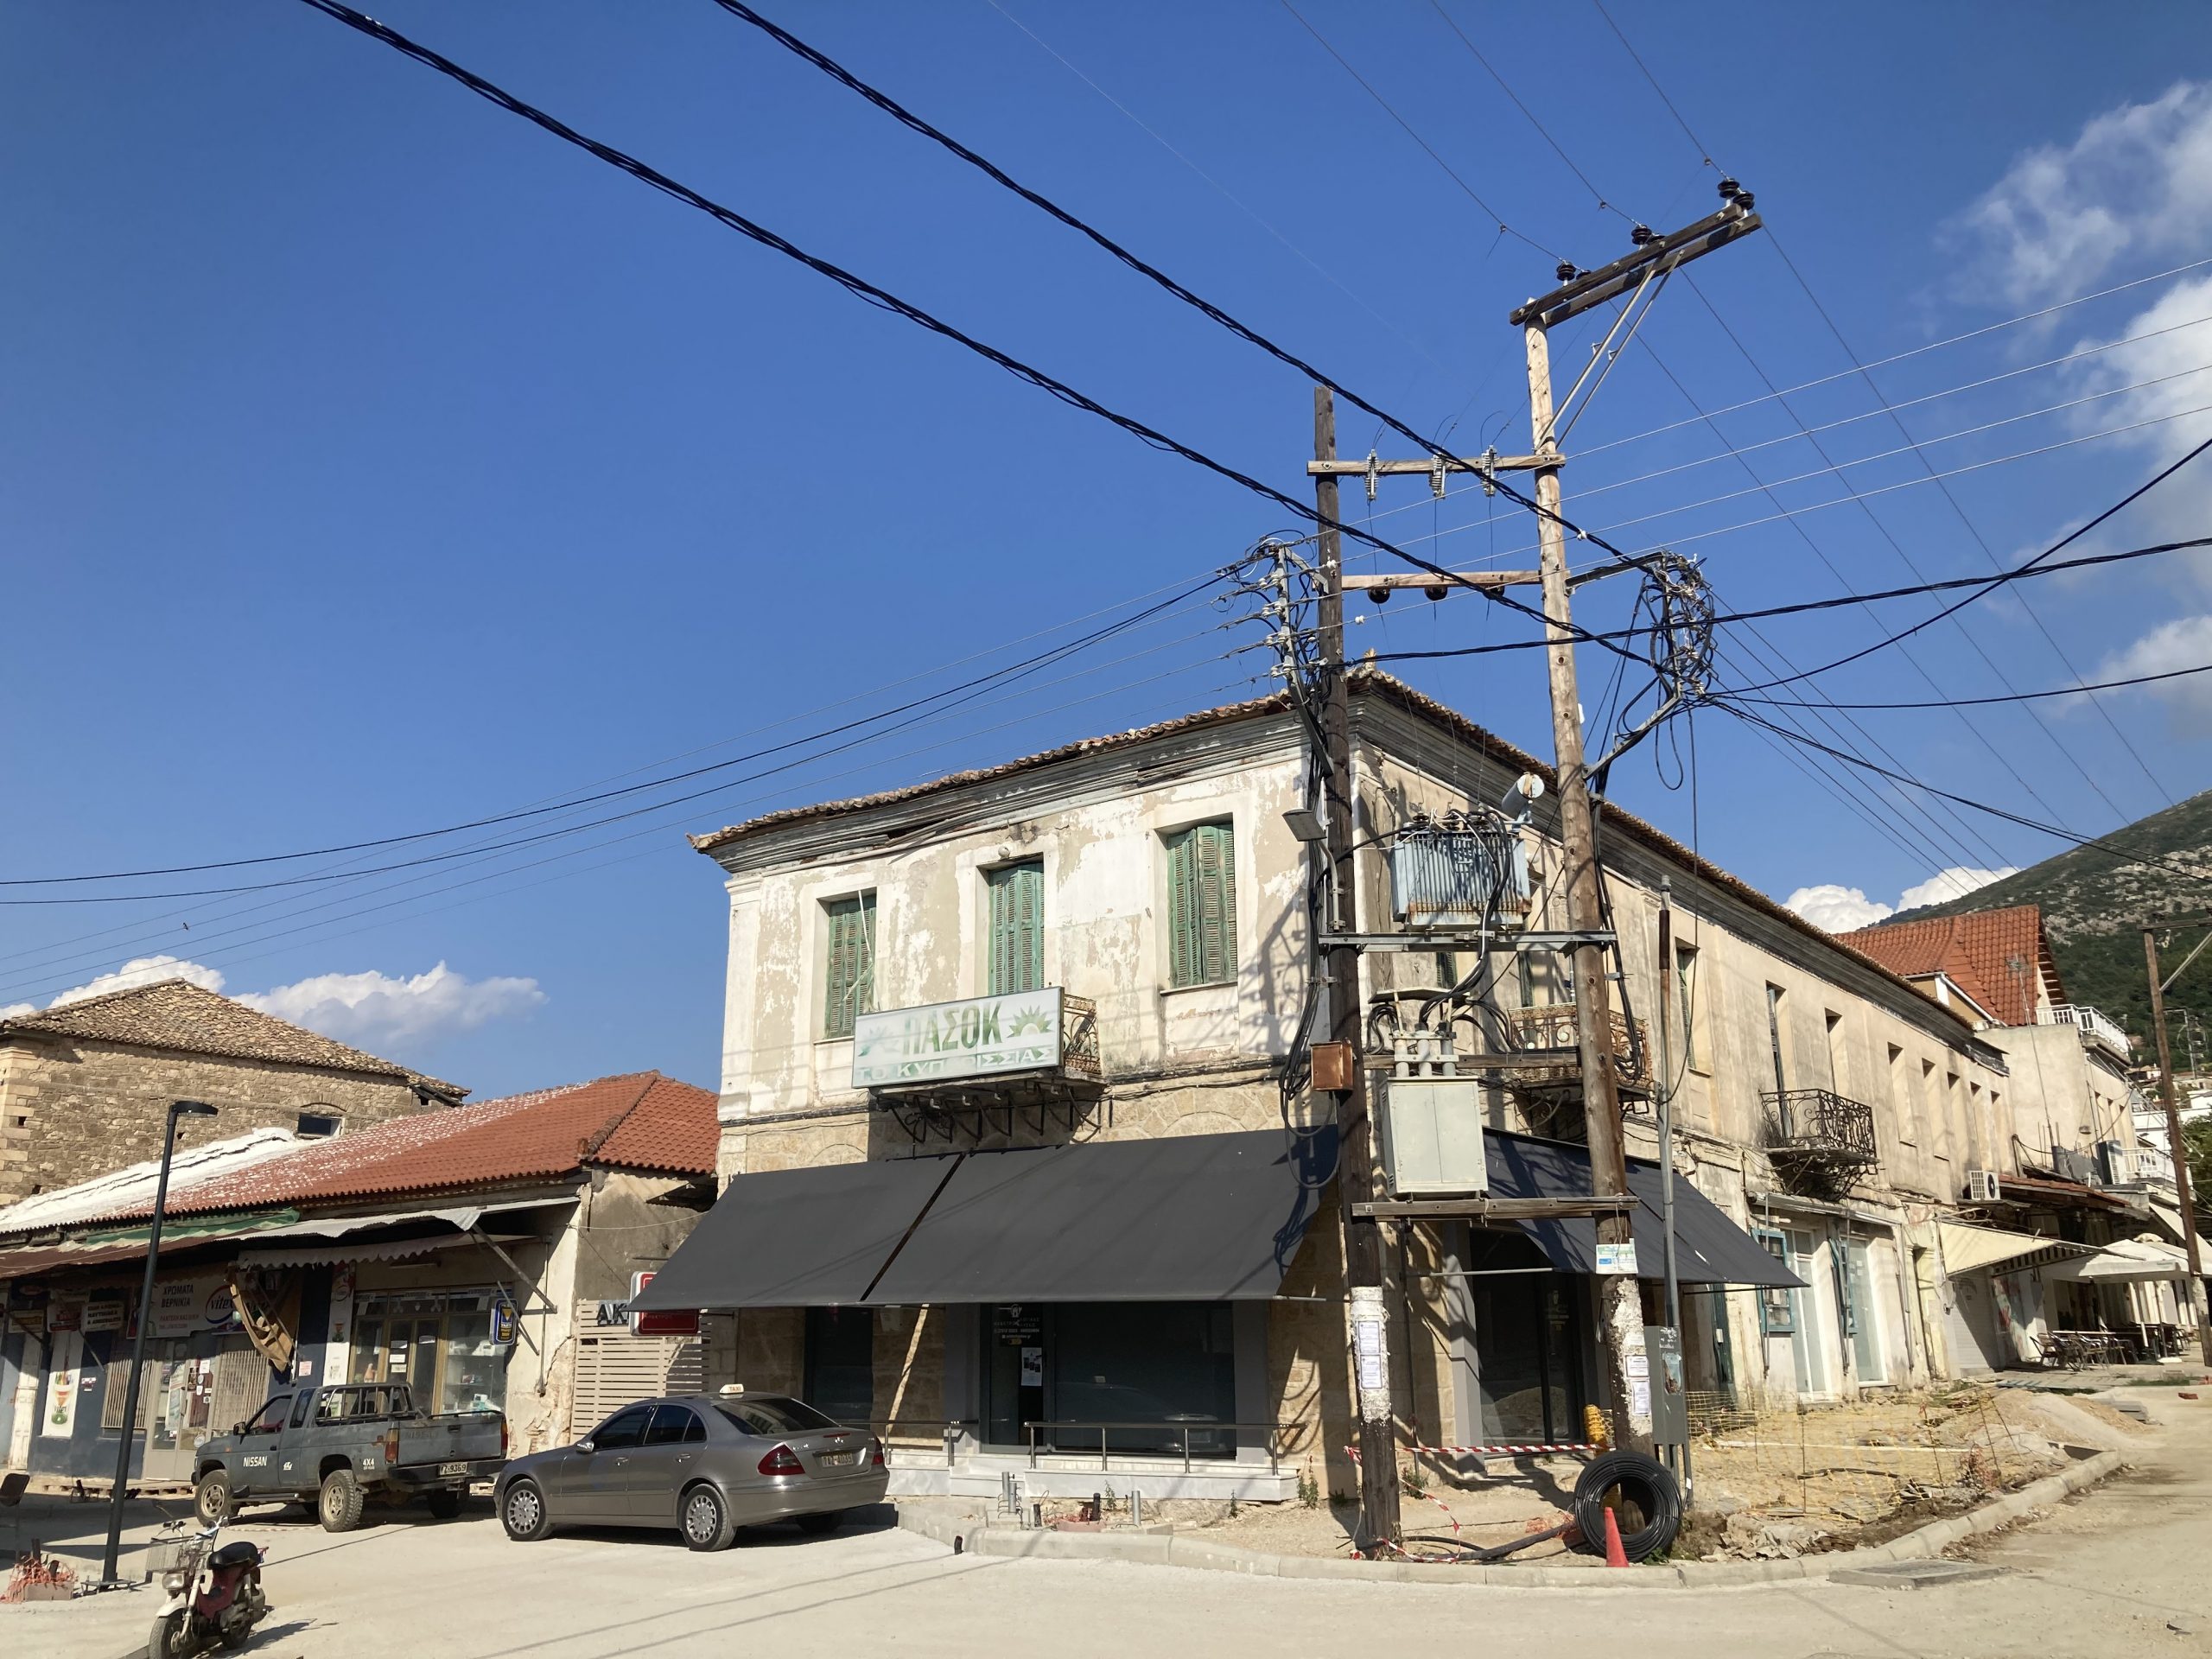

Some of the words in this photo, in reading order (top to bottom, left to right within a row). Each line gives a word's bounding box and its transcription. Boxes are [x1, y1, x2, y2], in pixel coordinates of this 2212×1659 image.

[902, 1001, 1004, 1055] ΠΑΣΟΚ
[163, 1284, 194, 1295] ΧΡΩΜΑΤΑ
[161, 1297, 190, 1308] ΒΕΡΝΙΚΙΑ
[243, 1456, 267, 1467] NISSAN
